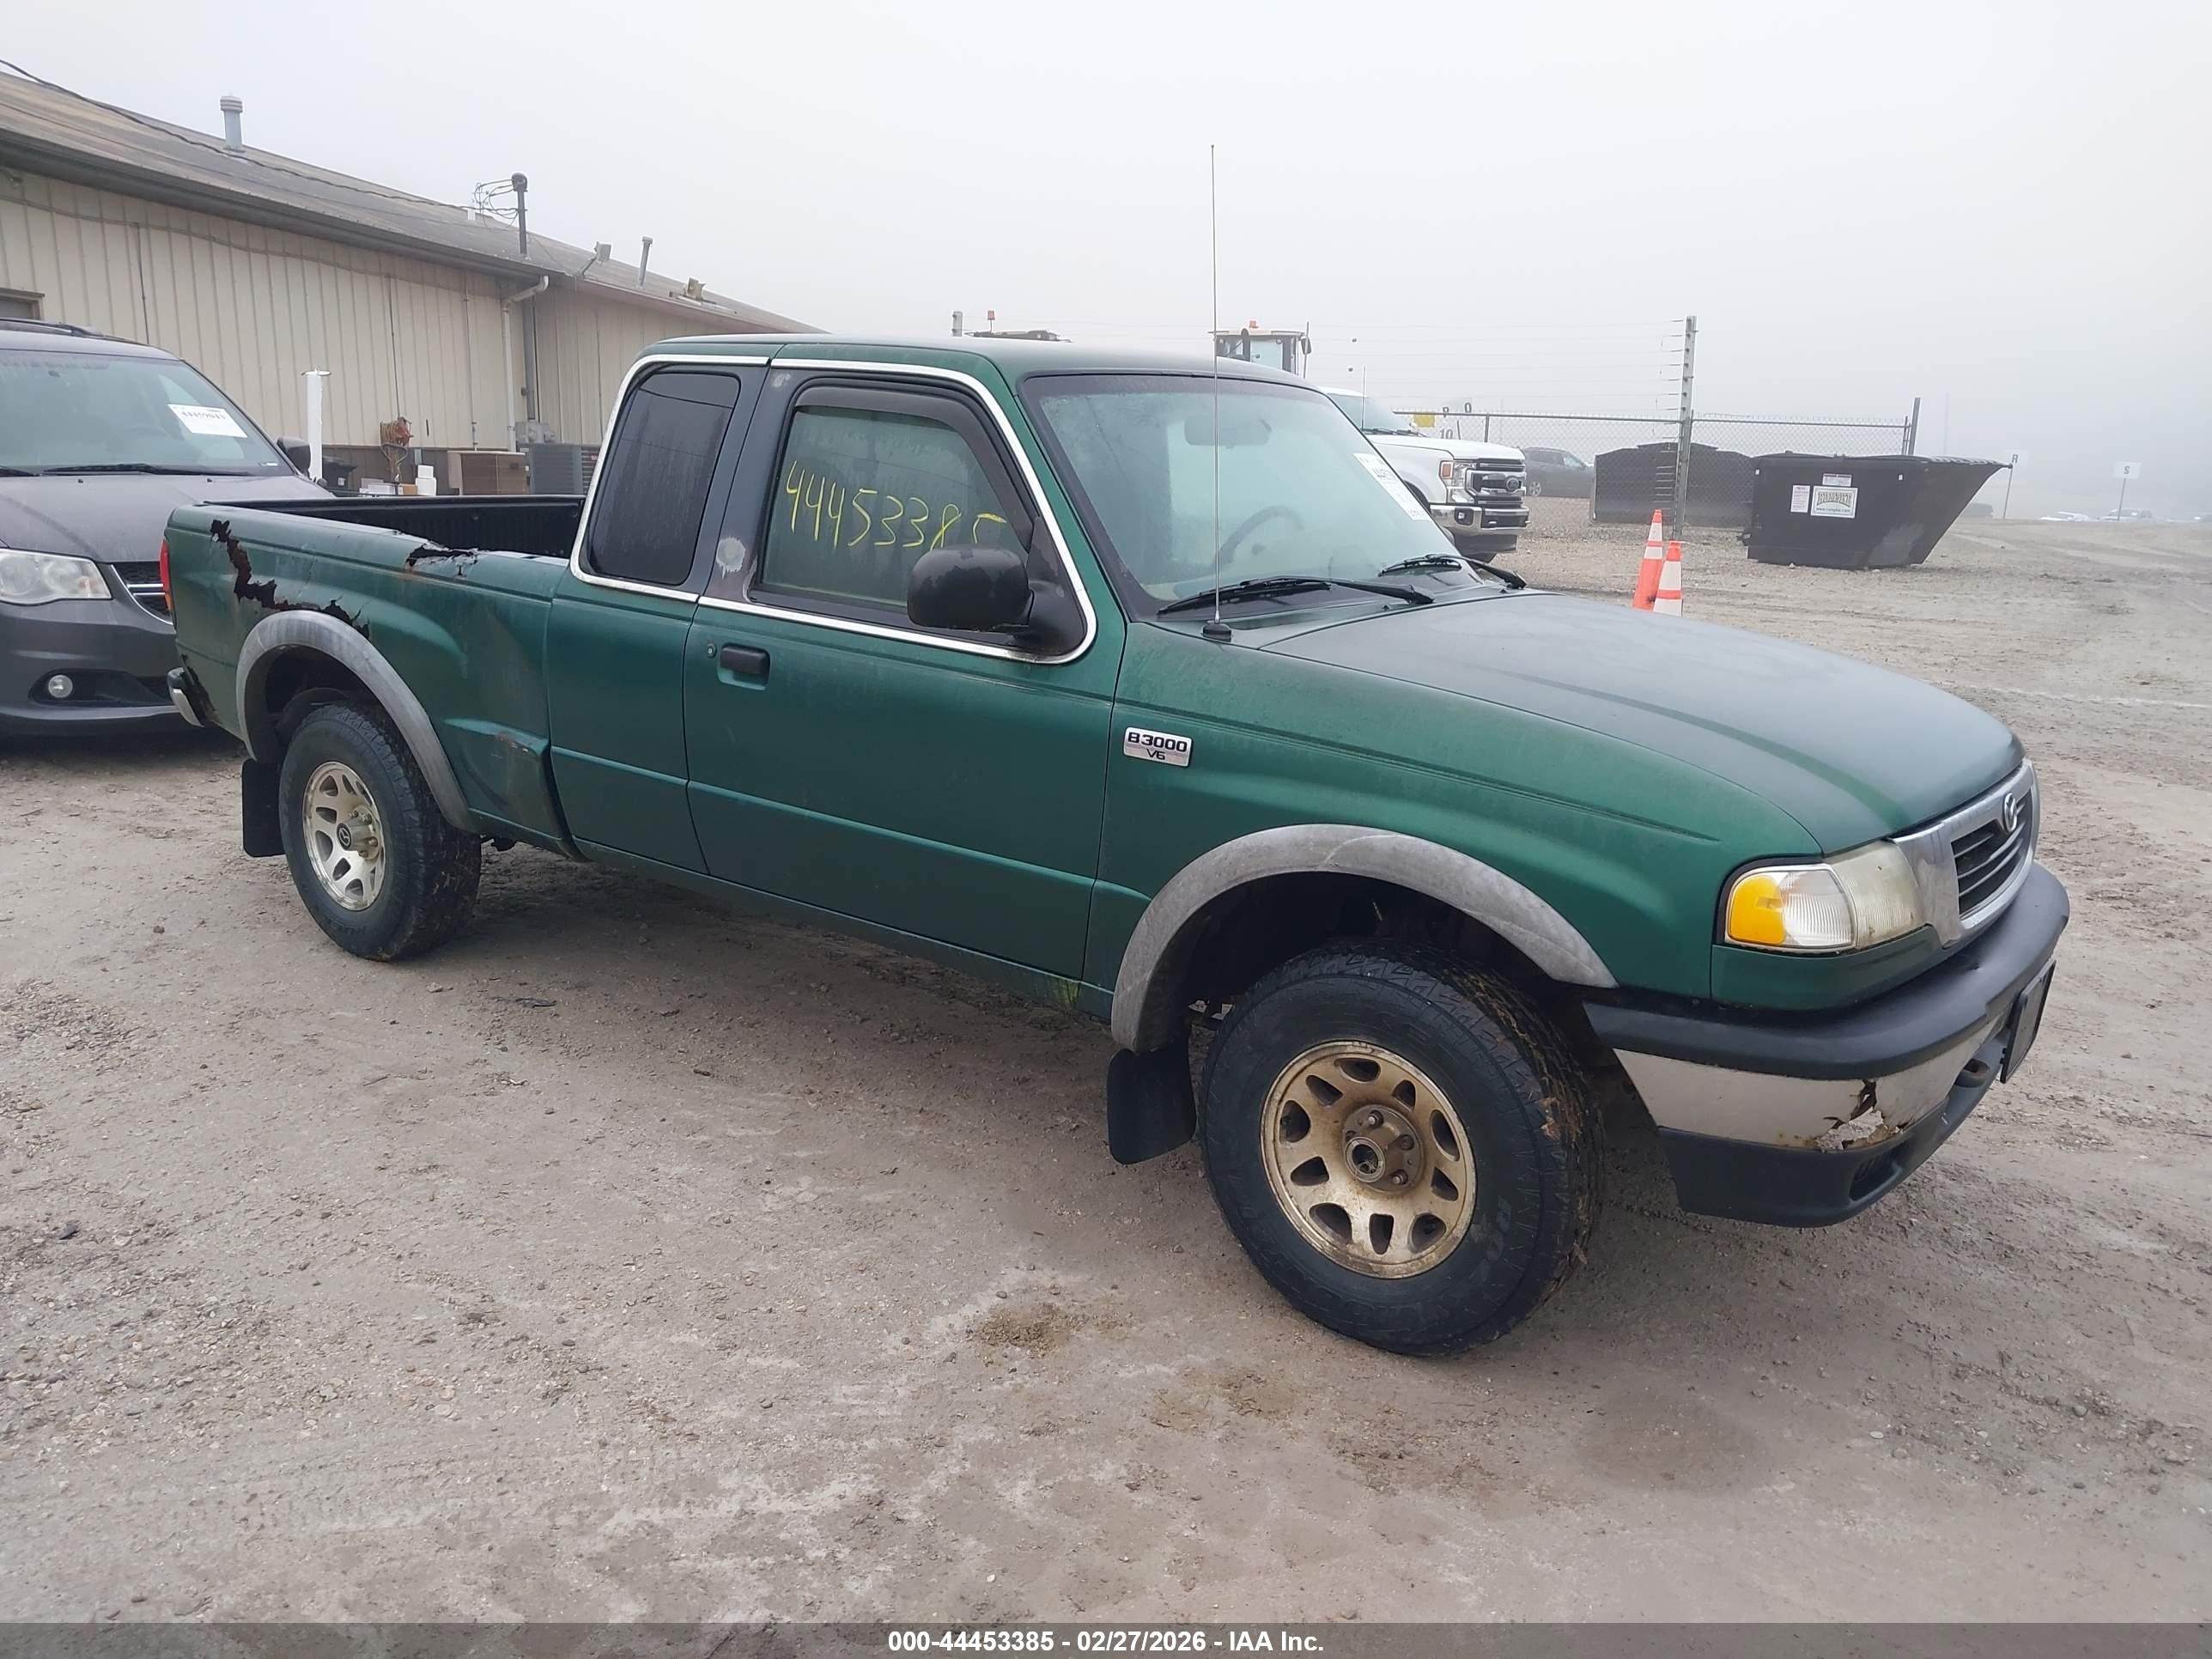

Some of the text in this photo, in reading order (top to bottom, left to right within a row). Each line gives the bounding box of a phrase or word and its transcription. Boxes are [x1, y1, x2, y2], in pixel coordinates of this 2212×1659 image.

[2012, 454, 2019, 464] R
[2124, 465, 2130, 475] S
[1127, 732, 1188, 752] B3000
[1146, 748, 1165, 760] V6
